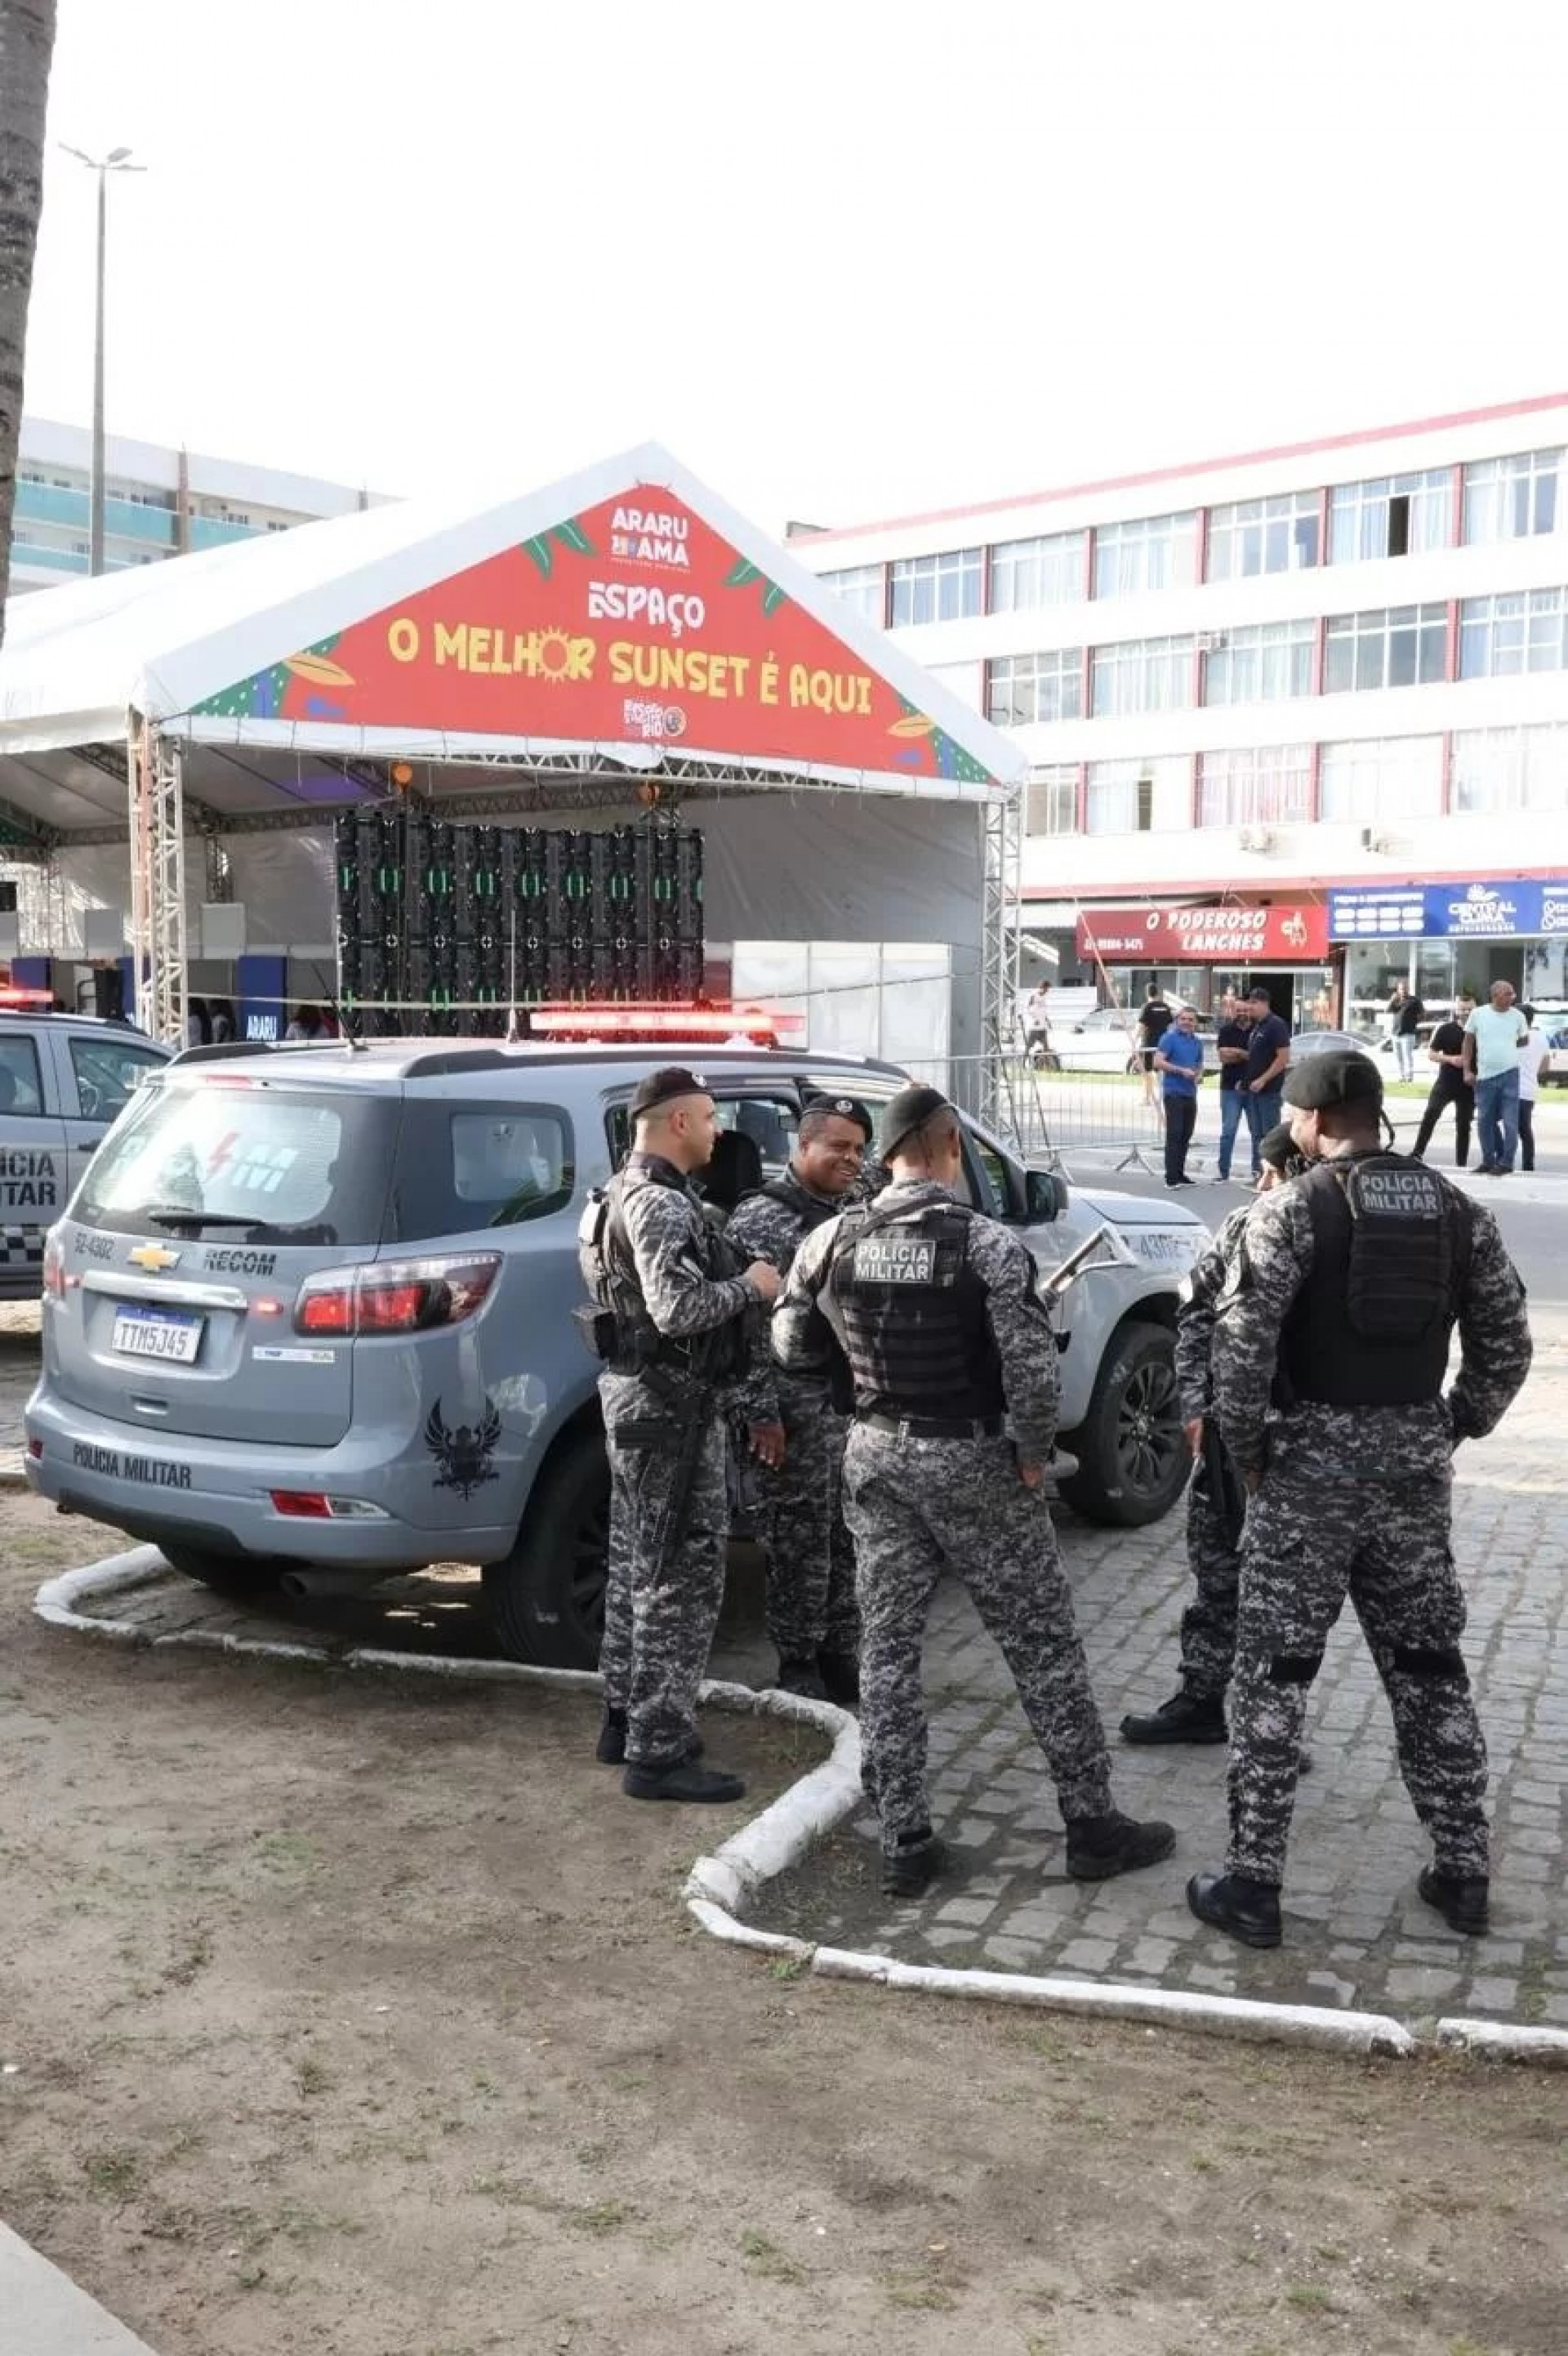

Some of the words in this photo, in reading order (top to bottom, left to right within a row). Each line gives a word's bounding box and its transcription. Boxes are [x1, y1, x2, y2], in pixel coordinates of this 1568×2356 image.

[611, 507, 688, 539] ARARU
[589, 581, 705, 636] ESPAÇO
[388, 618, 419, 663] O
[434, 622, 596, 683] MELHOR
[608, 641, 751, 698] SUNSET
[759, 650, 779, 704] É
[790, 663, 871, 716] AQUI
[1147, 912, 1160, 930] O
[1167, 910, 1267, 930] PODEROSO
[1180, 934, 1266, 951] LANCHES
[1363, 1192, 1437, 1211] MILITAR
[205, 1249, 277, 1276] RECOM
[856, 1263, 929, 1281] MILITAR
[124, 1455, 192, 1488] MILITAR
